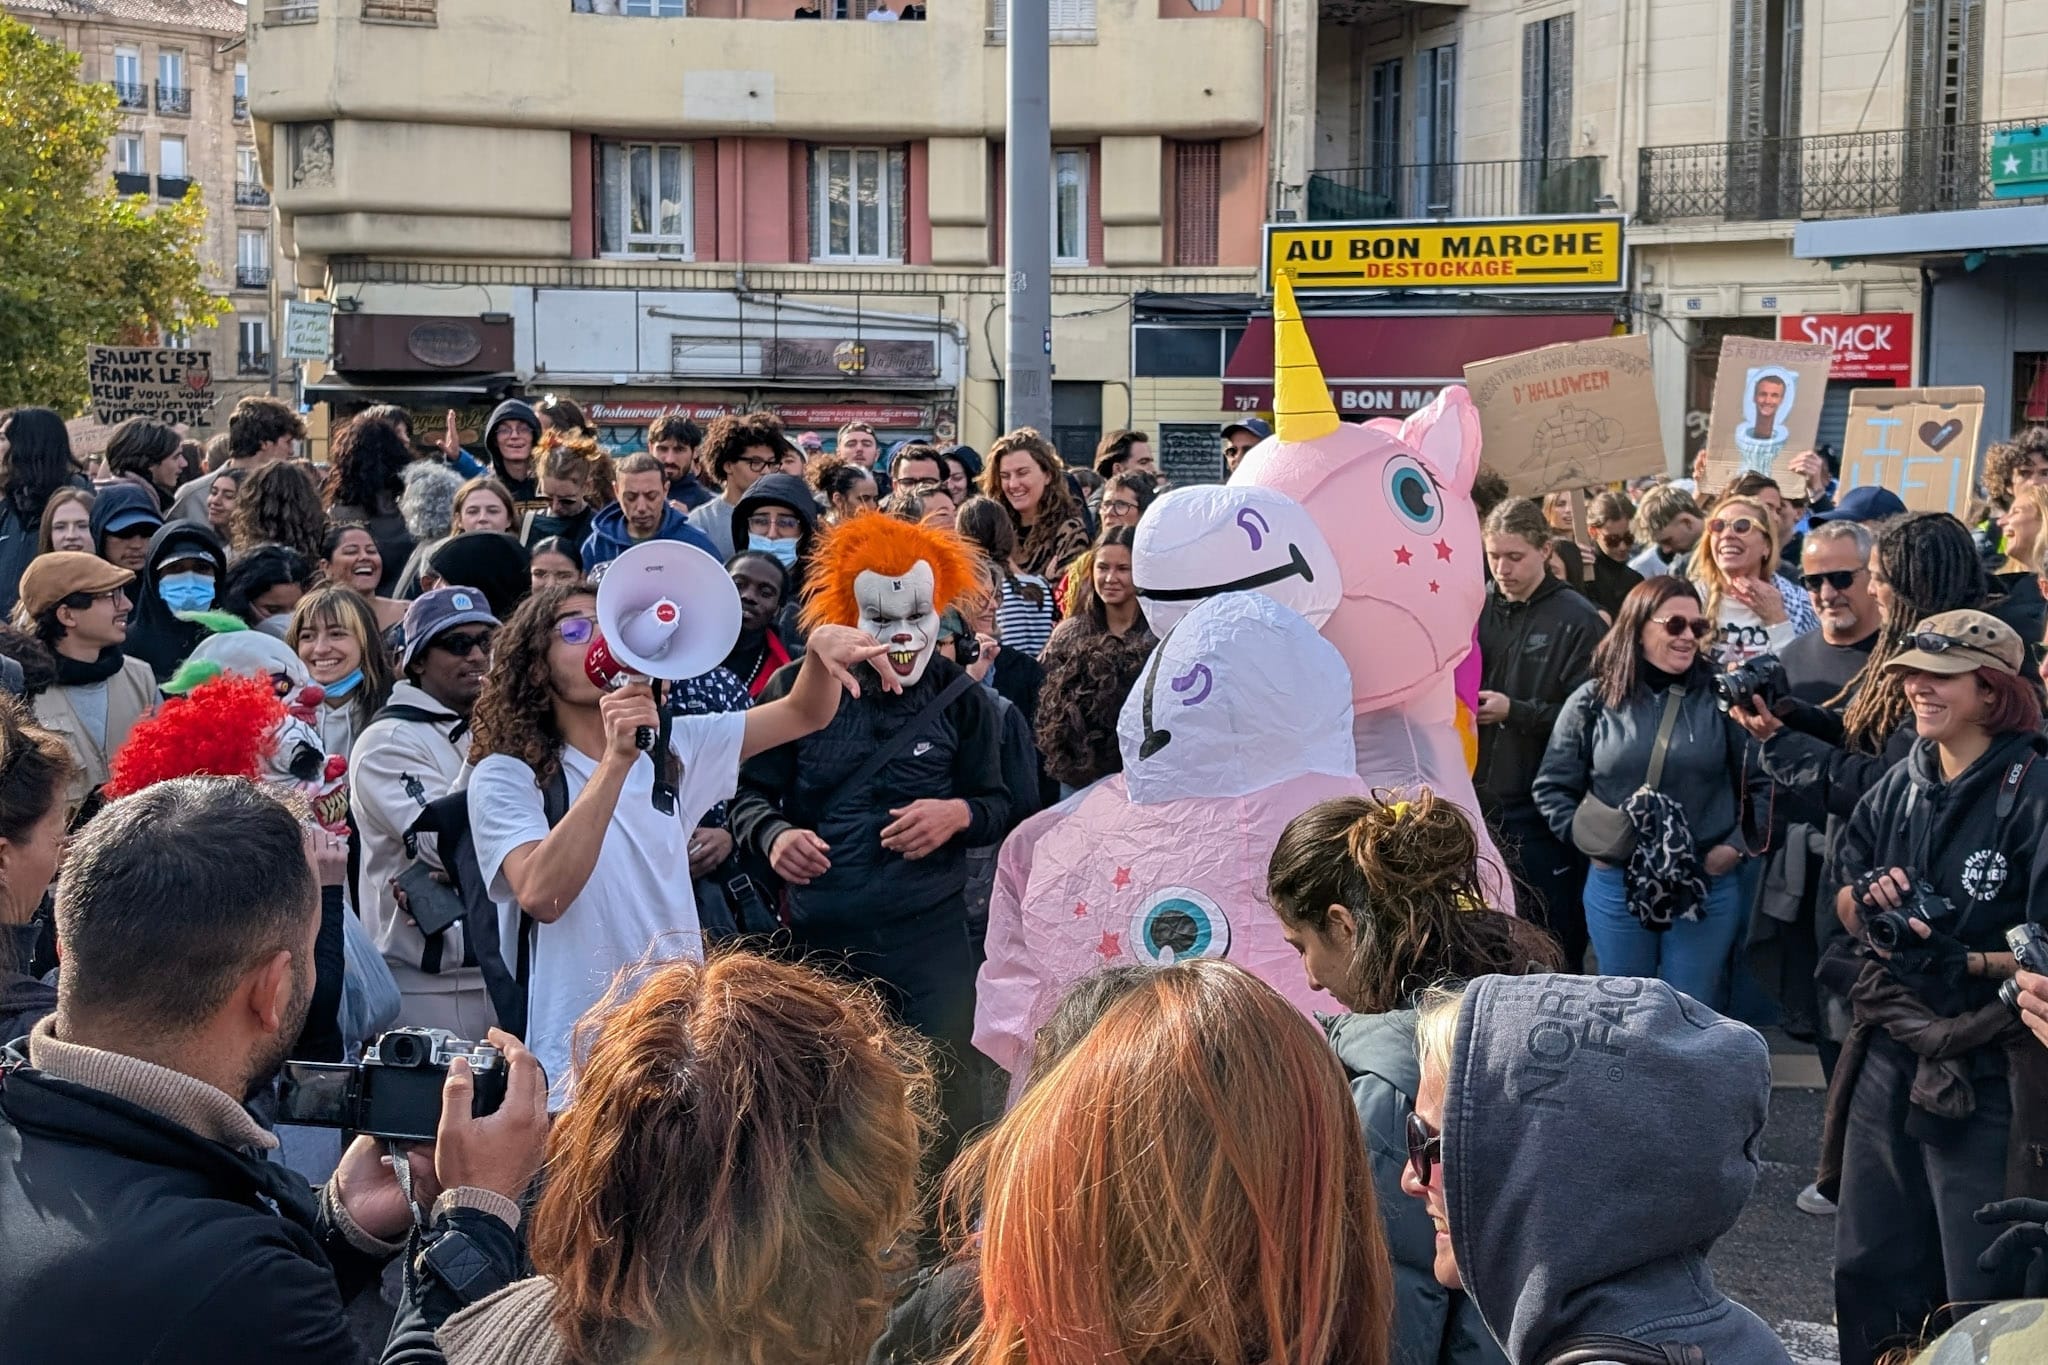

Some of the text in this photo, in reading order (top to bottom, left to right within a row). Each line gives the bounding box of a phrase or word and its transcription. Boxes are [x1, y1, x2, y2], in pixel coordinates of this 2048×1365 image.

[1286, 232, 1604, 261] AU BON MARCHE
[1367, 260, 1514, 278] DESTOCKAGE
[1801, 316, 1892, 351] SNACK
[94, 349, 211, 368] SALUT C'EST
[90, 364, 181, 384] FRANK LE
[1513, 371, 1609, 405] D'HALLOWEEN
[132, 399, 183, 409] combien
[1341, 391, 1393, 409] BON
[98, 408, 158, 425] VOTE
[592, 404, 666, 419] Restaurant
[695, 405, 726, 418] amis
[1862, 418, 1903, 456] I
[2009, 763, 2023, 784] EOS
[1580, 977, 1644, 1058] FAC
[1518, 974, 1595, 1111] NORT
